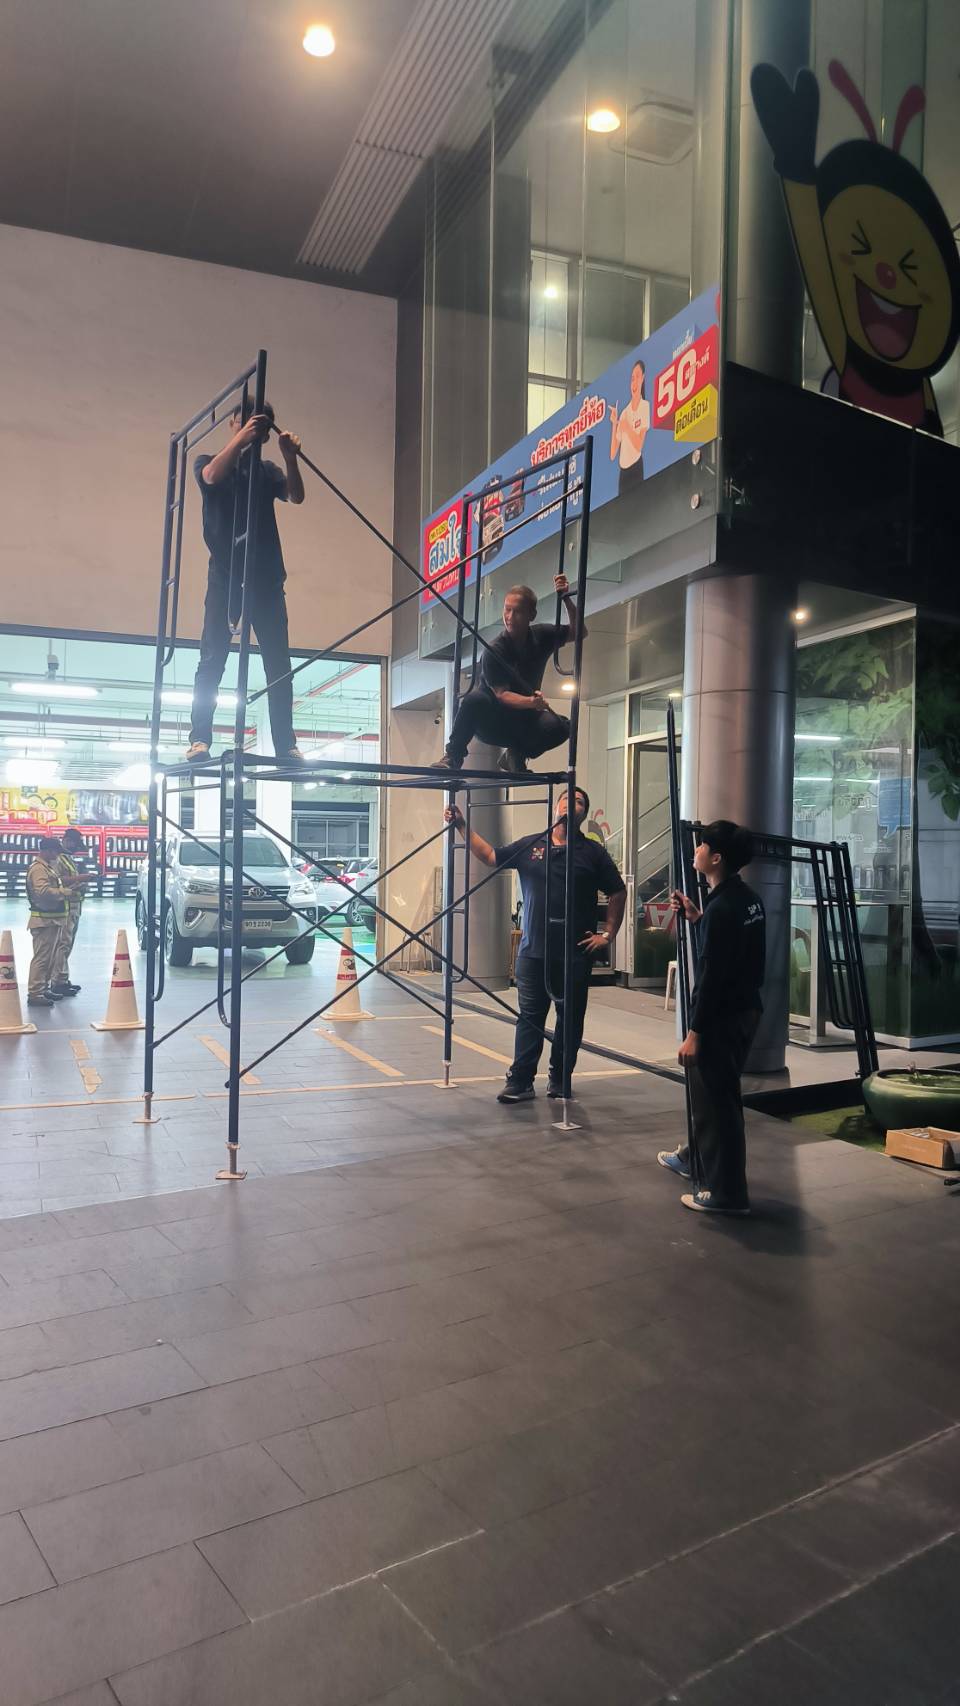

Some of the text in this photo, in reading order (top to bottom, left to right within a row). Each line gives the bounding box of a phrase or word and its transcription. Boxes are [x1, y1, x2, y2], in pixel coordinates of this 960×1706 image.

[657, 348, 697, 418] 50
[675, 397, 709, 434] ต่อเดือน
[531, 395, 606, 467] บริการทุกยี่ห้อ
